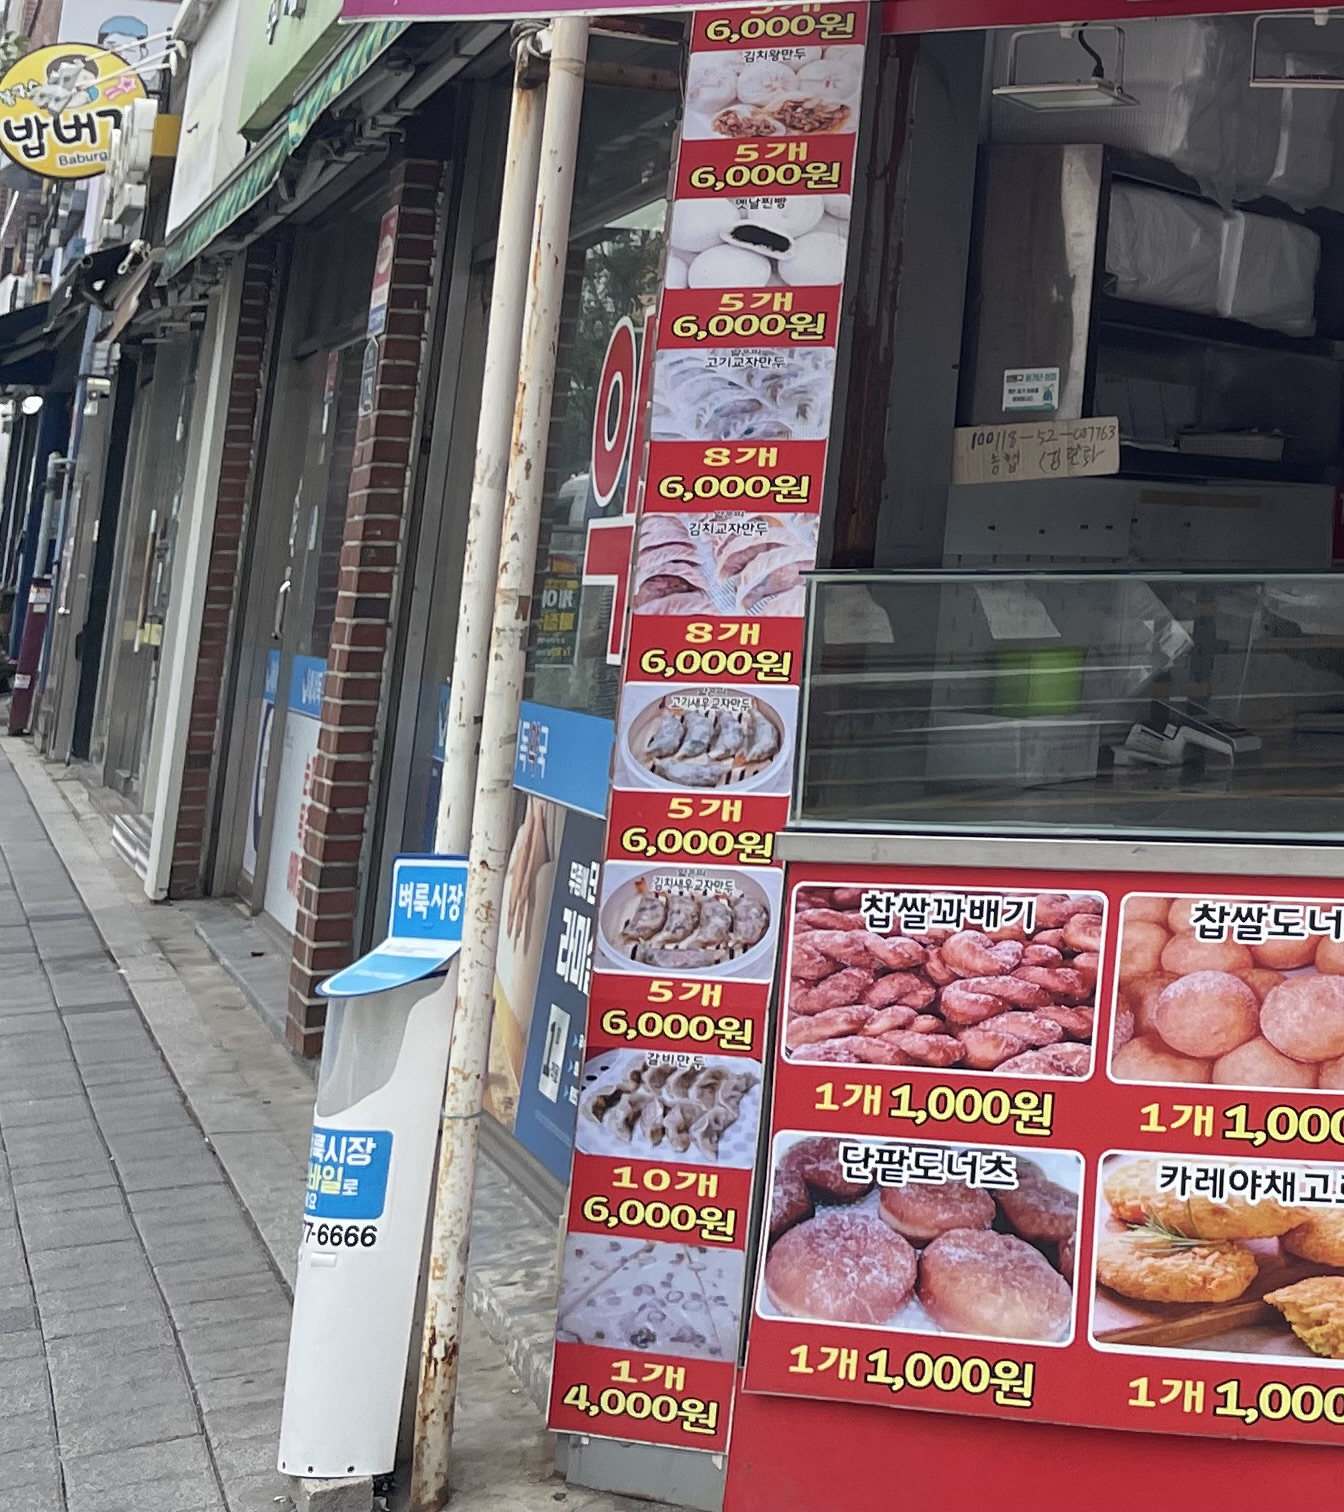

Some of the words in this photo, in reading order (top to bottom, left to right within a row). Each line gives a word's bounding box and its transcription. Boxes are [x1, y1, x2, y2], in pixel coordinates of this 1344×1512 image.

[706, 12, 855, 42] 6,000원
[743, 48, 807, 63] 김치왕만두
[58, 151, 111, 168] Baburg
[734, 141, 808, 162] 5개
[690, 162, 841, 191] 6,000원
[718, 292, 793, 313] 5개
[672, 312, 826, 341] 6,000원
[705, 356, 787, 369] 고기교자만두
[703, 446, 778, 468] 8개
[659, 475, 810, 504] 6,000원
[688, 522, 769, 537] 김치교자만두
[685, 621, 761, 646] 8개
[640, 649, 792, 682] 6,000원
[667, 798, 742, 823] 5개
[622, 828, 774, 864] 6,000원
[399, 880, 464, 922] 벼룩시장
[862, 891, 1035, 930] 찹쌀꽈배기
[647, 981, 723, 1008] 5개
[601, 1010, 754, 1051] 6,000원
[647, 1051, 707, 1069] 갈비만두
[815, 1082, 882, 1116] 1개
[890, 1083, 1054, 1136] 1,000원
[1140, 1104, 1214, 1138] 1개
[311, 1133, 377, 1166] 룩시장
[841, 1145, 1017, 1187] 단팥도너츠
[611, 1166, 719, 1198] 10개
[582, 1196, 738, 1243] 6,000원
[610, 1360, 687, 1391] 1개
[788, 1345, 857, 1380] 1개
[866, 1348, 1036, 1407] 1,000원
[563, 1384, 719, 1435] 4,000원
[1128, 1377, 1204, 1415] 1개
